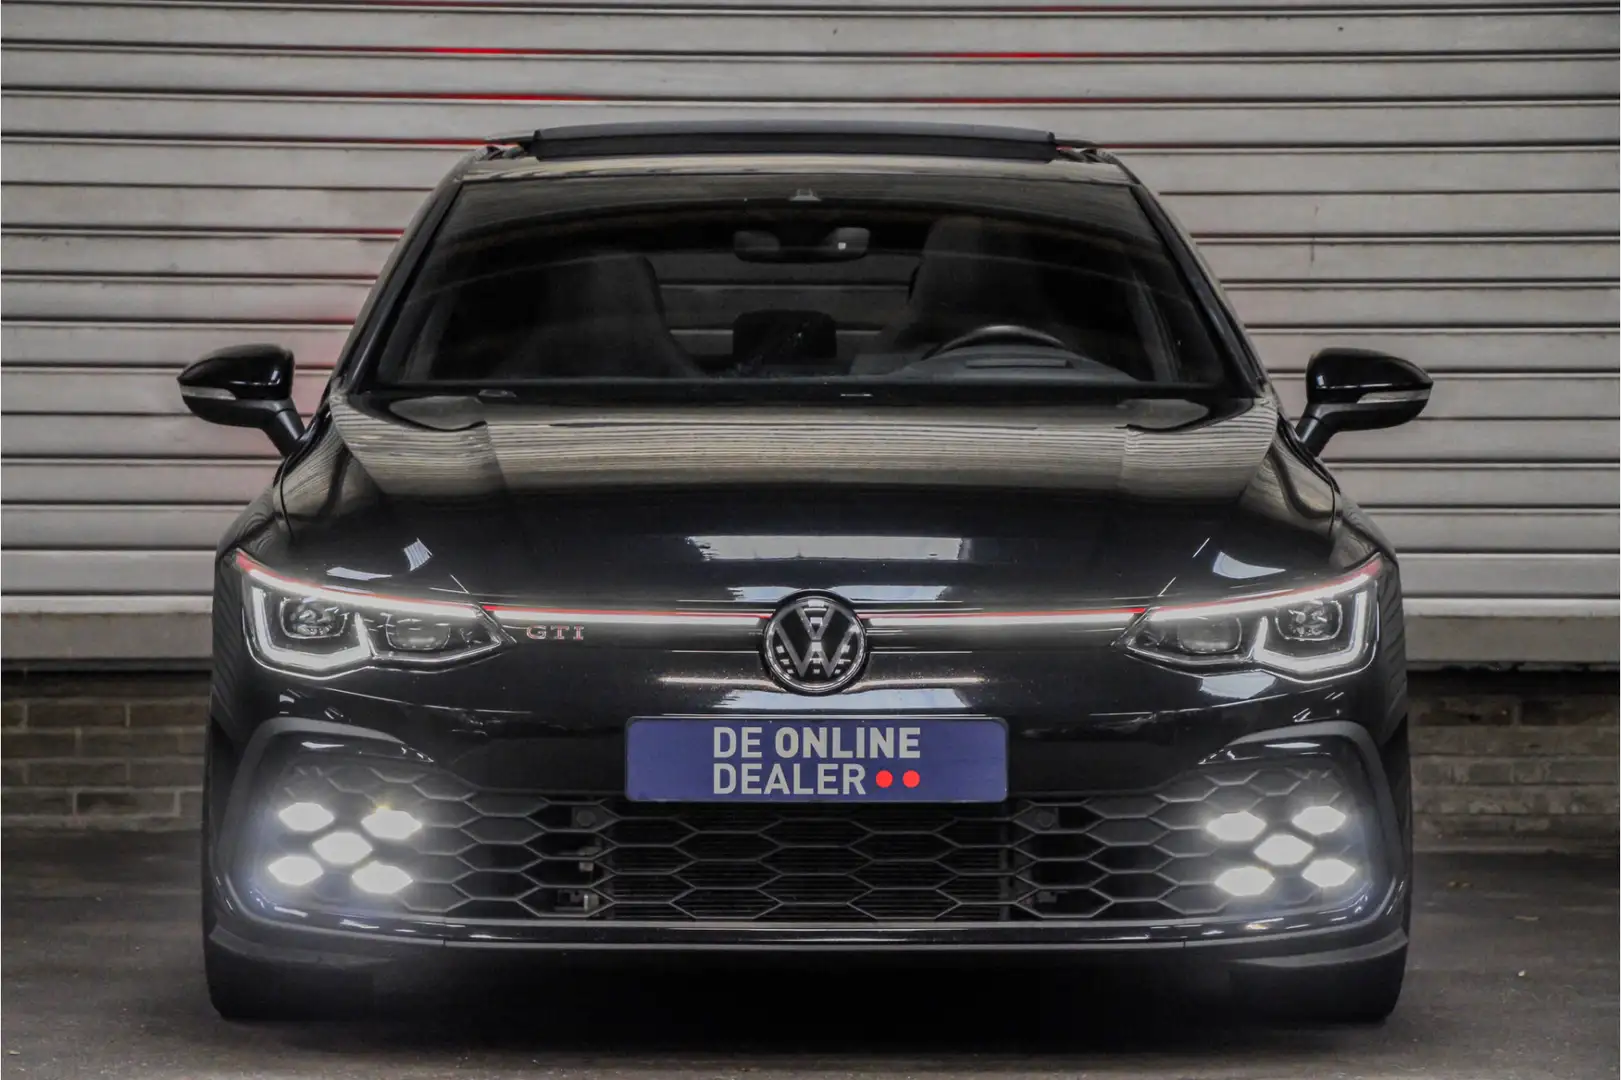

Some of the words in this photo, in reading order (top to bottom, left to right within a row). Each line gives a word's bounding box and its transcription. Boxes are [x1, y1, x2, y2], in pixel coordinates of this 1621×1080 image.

[526, 624, 584, 640] GTI
[713, 727, 763, 759] DE
[775, 727, 921, 759] ONLINE
[713, 763, 866, 795] DEALER
